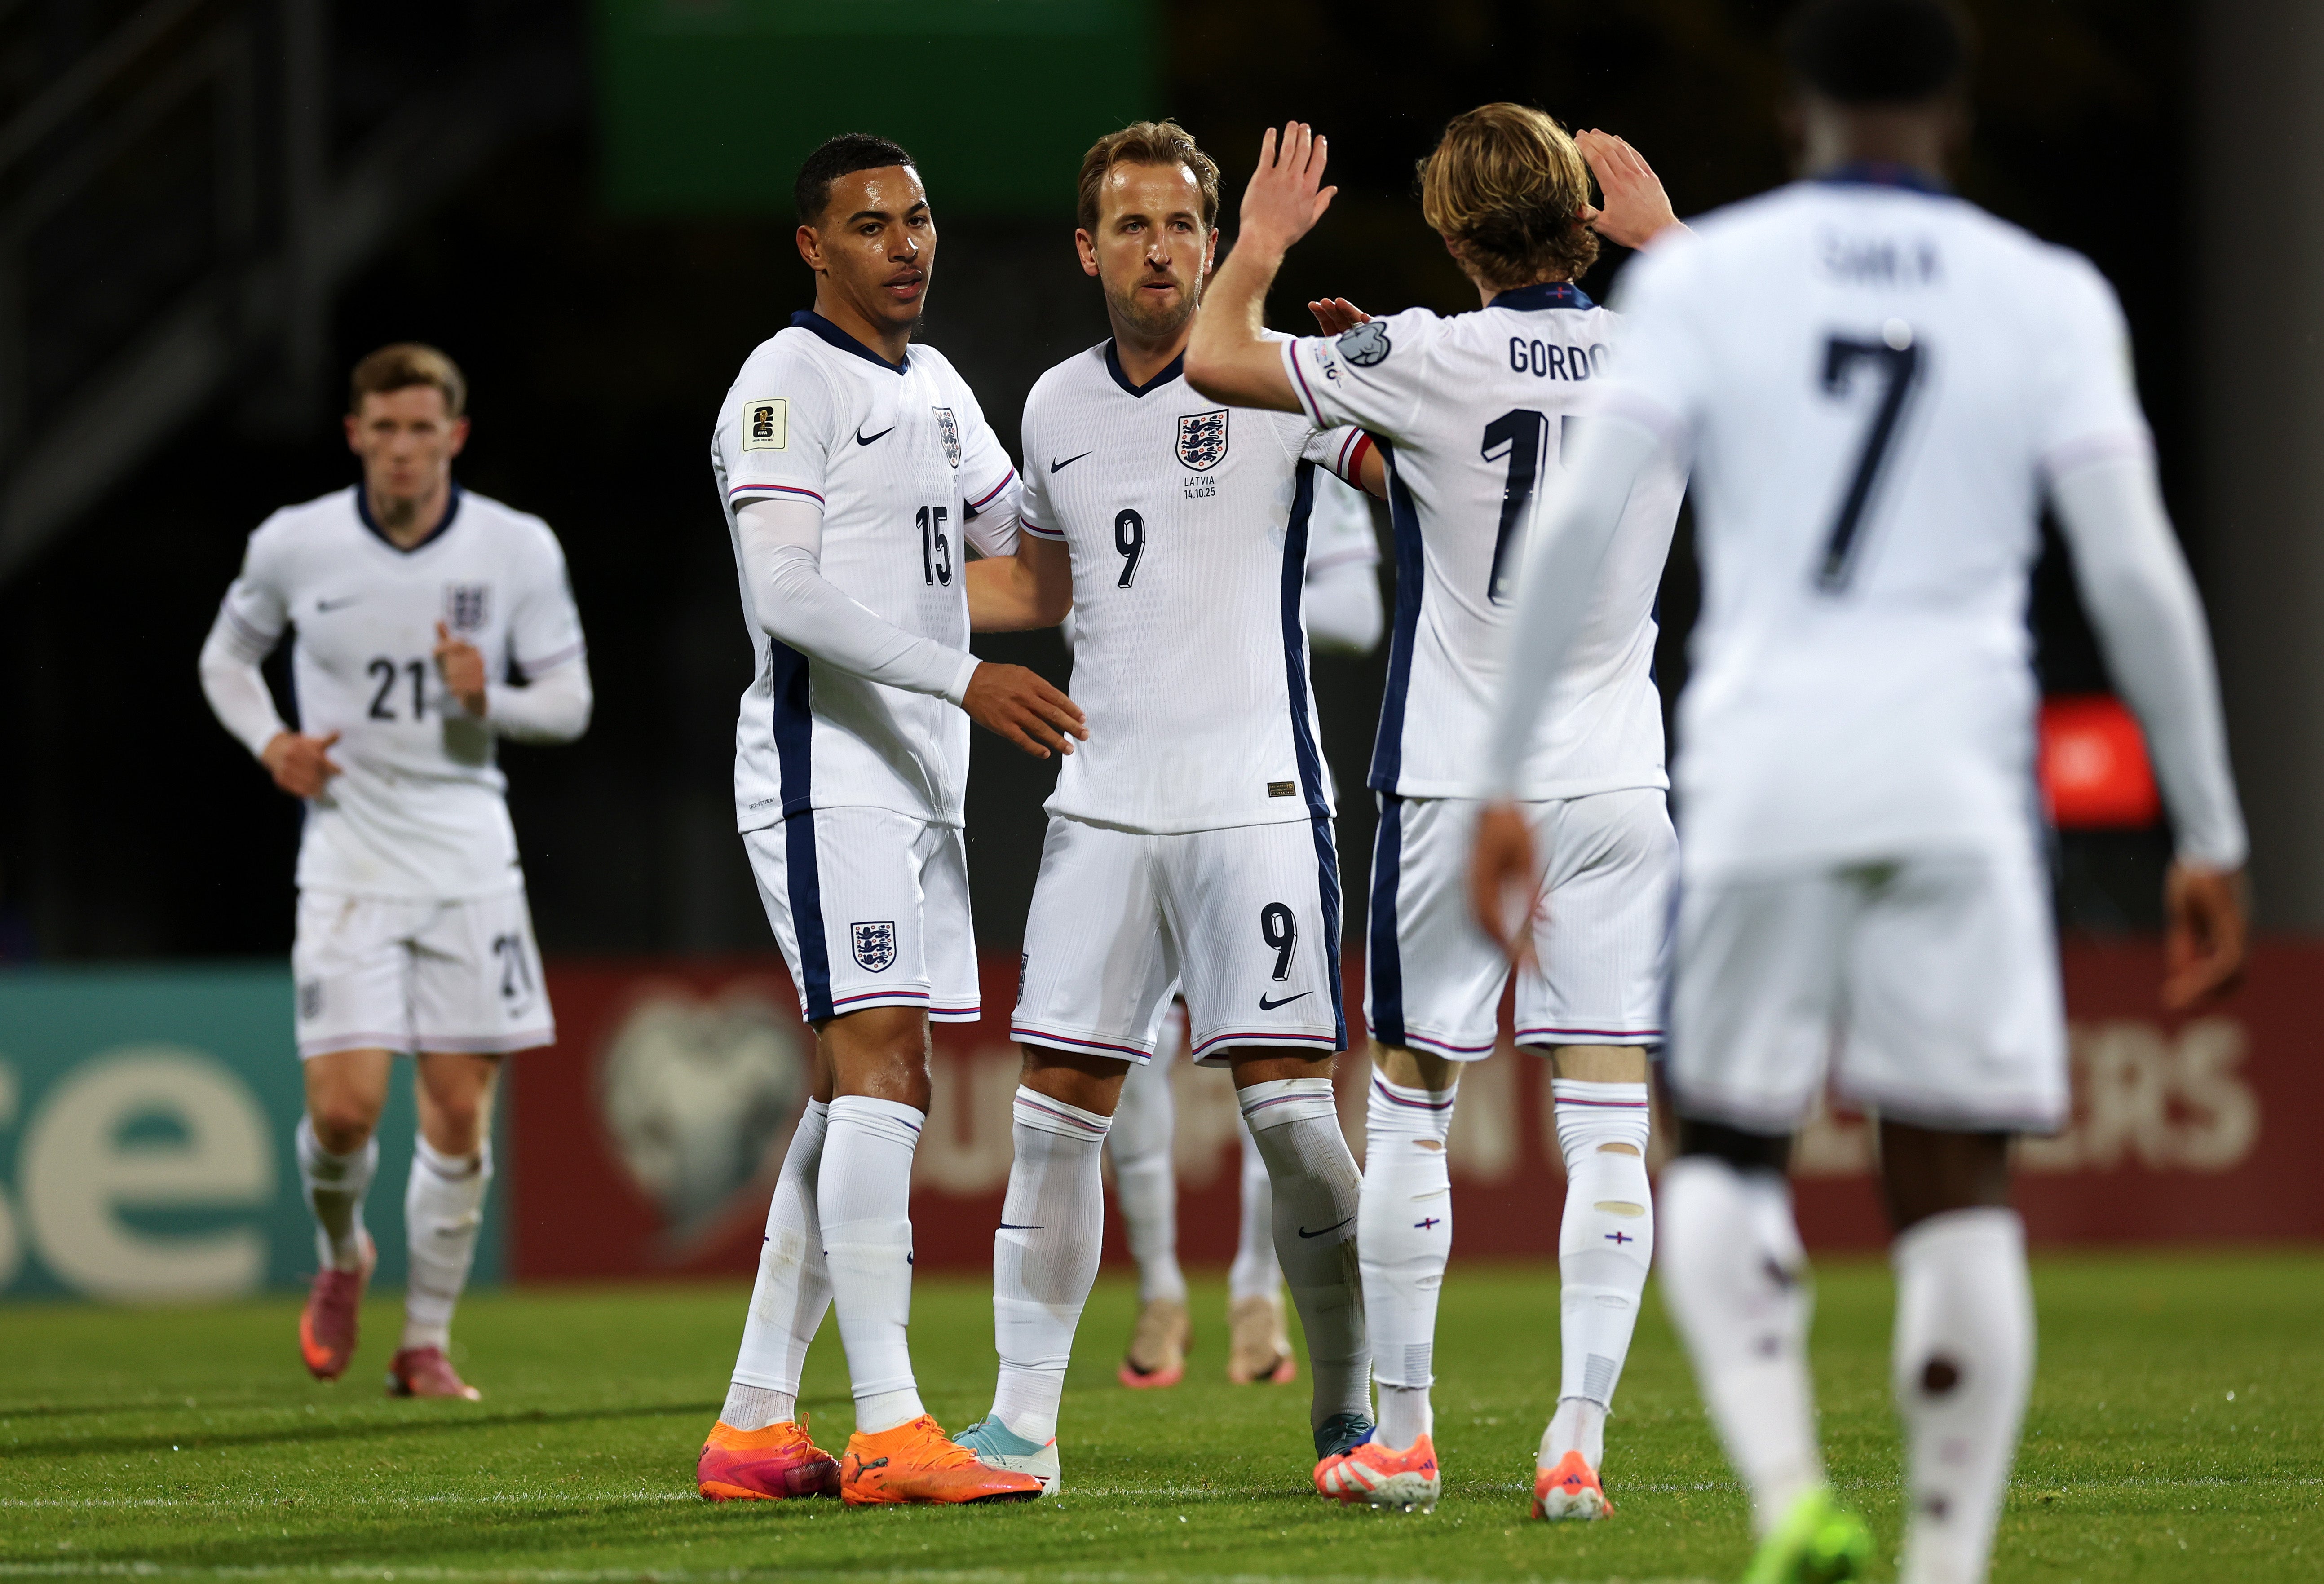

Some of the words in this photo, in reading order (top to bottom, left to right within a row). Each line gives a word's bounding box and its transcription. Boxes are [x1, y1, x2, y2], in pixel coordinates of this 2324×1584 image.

[1510, 337, 1618, 381] GORDO
[1184, 476, 1214, 486] LATVIA
[1184, 487, 1215, 499] 14.10.25
[1817, 331, 1931, 593] 7
[916, 506, 952, 587] 15
[1115, 508, 1145, 589] 9
[368, 657, 424, 722] 21
[492, 933, 535, 998] 21
[1261, 902, 1298, 981] 9
